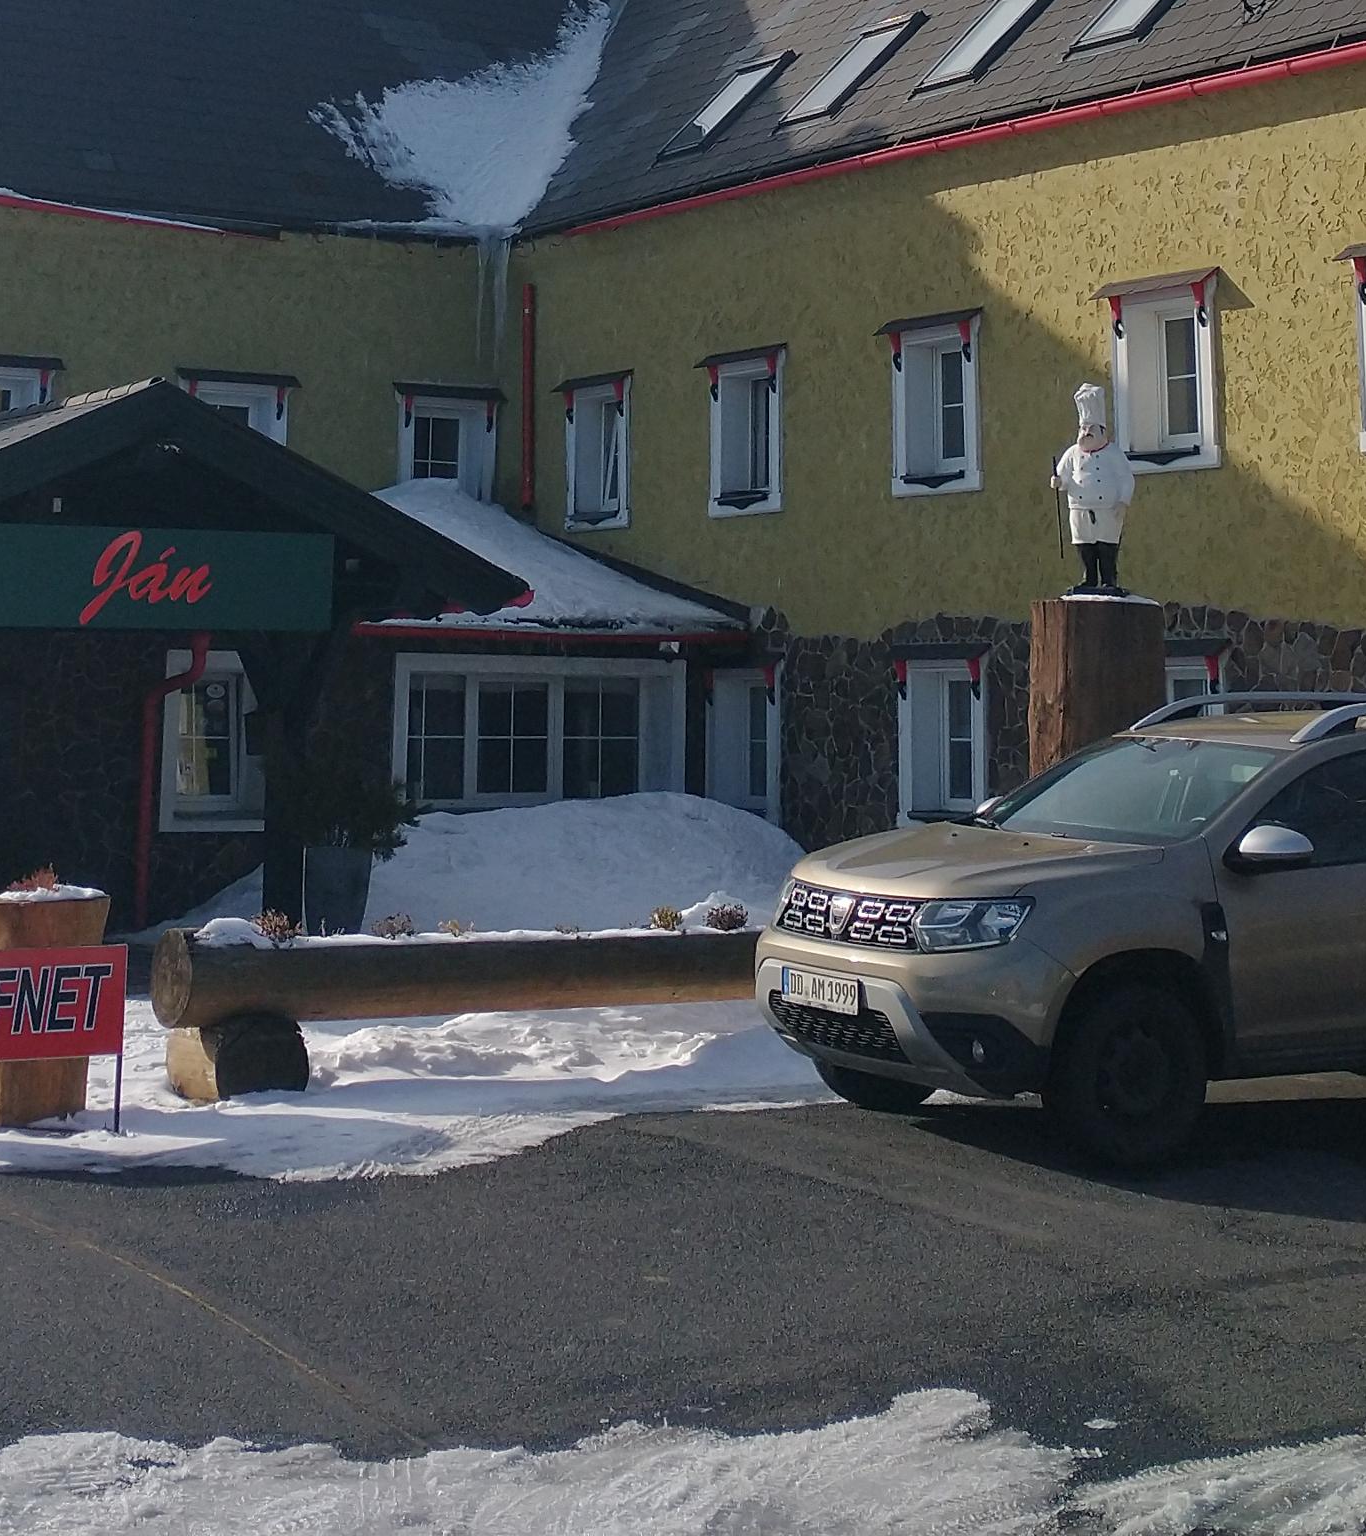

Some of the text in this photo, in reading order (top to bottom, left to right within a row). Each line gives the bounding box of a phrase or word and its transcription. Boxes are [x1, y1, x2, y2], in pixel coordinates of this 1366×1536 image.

[79, 530, 212, 625] Ján
[790, 972, 804, 995] DD
[828, 980, 856, 1006] 1999
